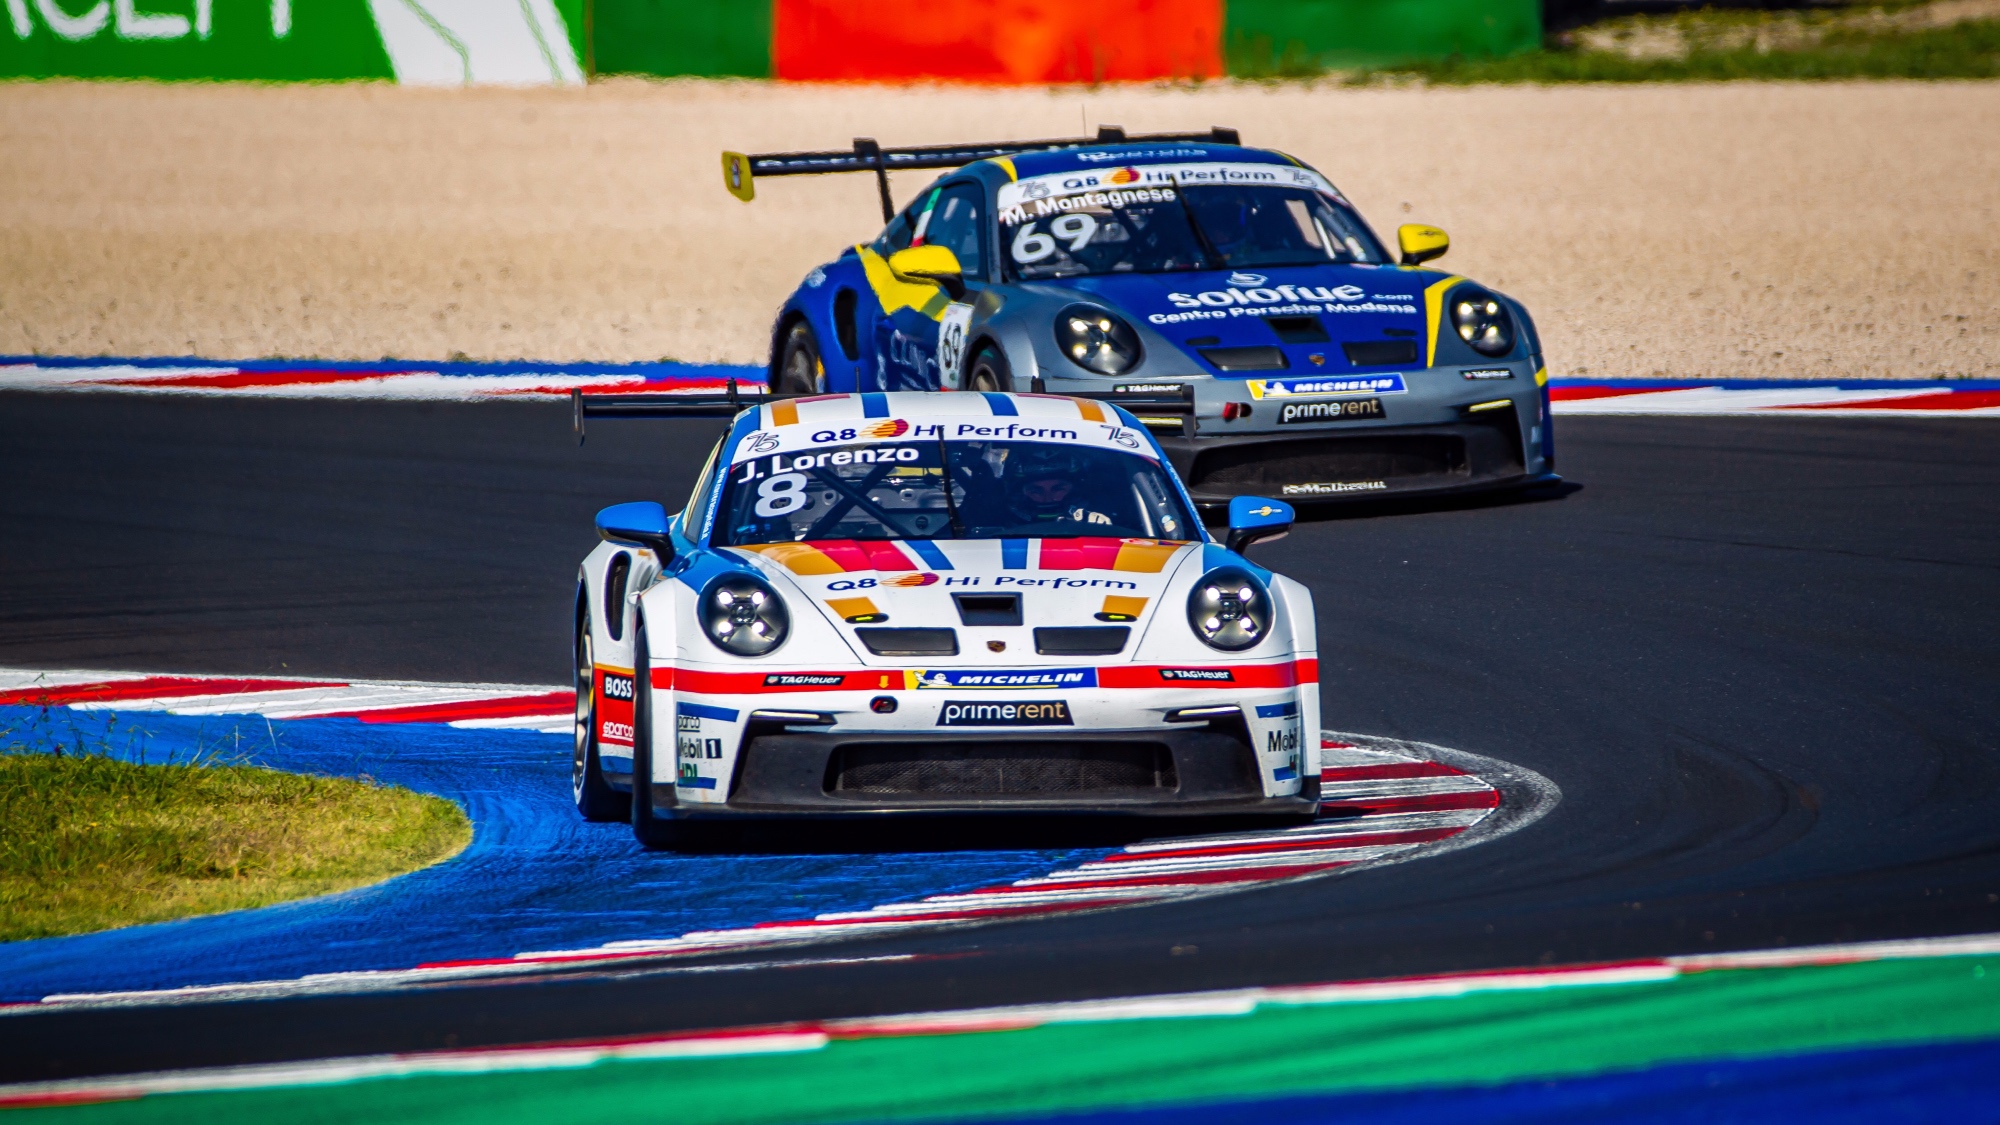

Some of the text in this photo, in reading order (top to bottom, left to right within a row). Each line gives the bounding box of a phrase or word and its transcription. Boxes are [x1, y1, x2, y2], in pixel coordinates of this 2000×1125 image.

[1063, 177, 1099, 190] Q8
[1180, 167, 1276, 184] Perform
[1005, 188, 1177, 228] M. Montagnese
[1011, 214, 1097, 264] 69
[1148, 301, 1417, 325] Centro Porsche Modena
[942, 322, 962, 370] 69
[1294, 379, 1393, 393] MICHELIN
[1283, 399, 1379, 423] primerent
[811, 428, 857, 443] Q8
[957, 424, 1077, 440] Perform
[737, 448, 919, 483] J. Lorenzo
[754, 472, 808, 518] 8
[826, 576, 1137, 591] Q8 Hi Perform
[604, 676, 633, 698] BOSS
[958, 673, 1083, 685] MICHELIN
[945, 701, 1065, 724] primerent
[602, 721, 634, 739] sparco
